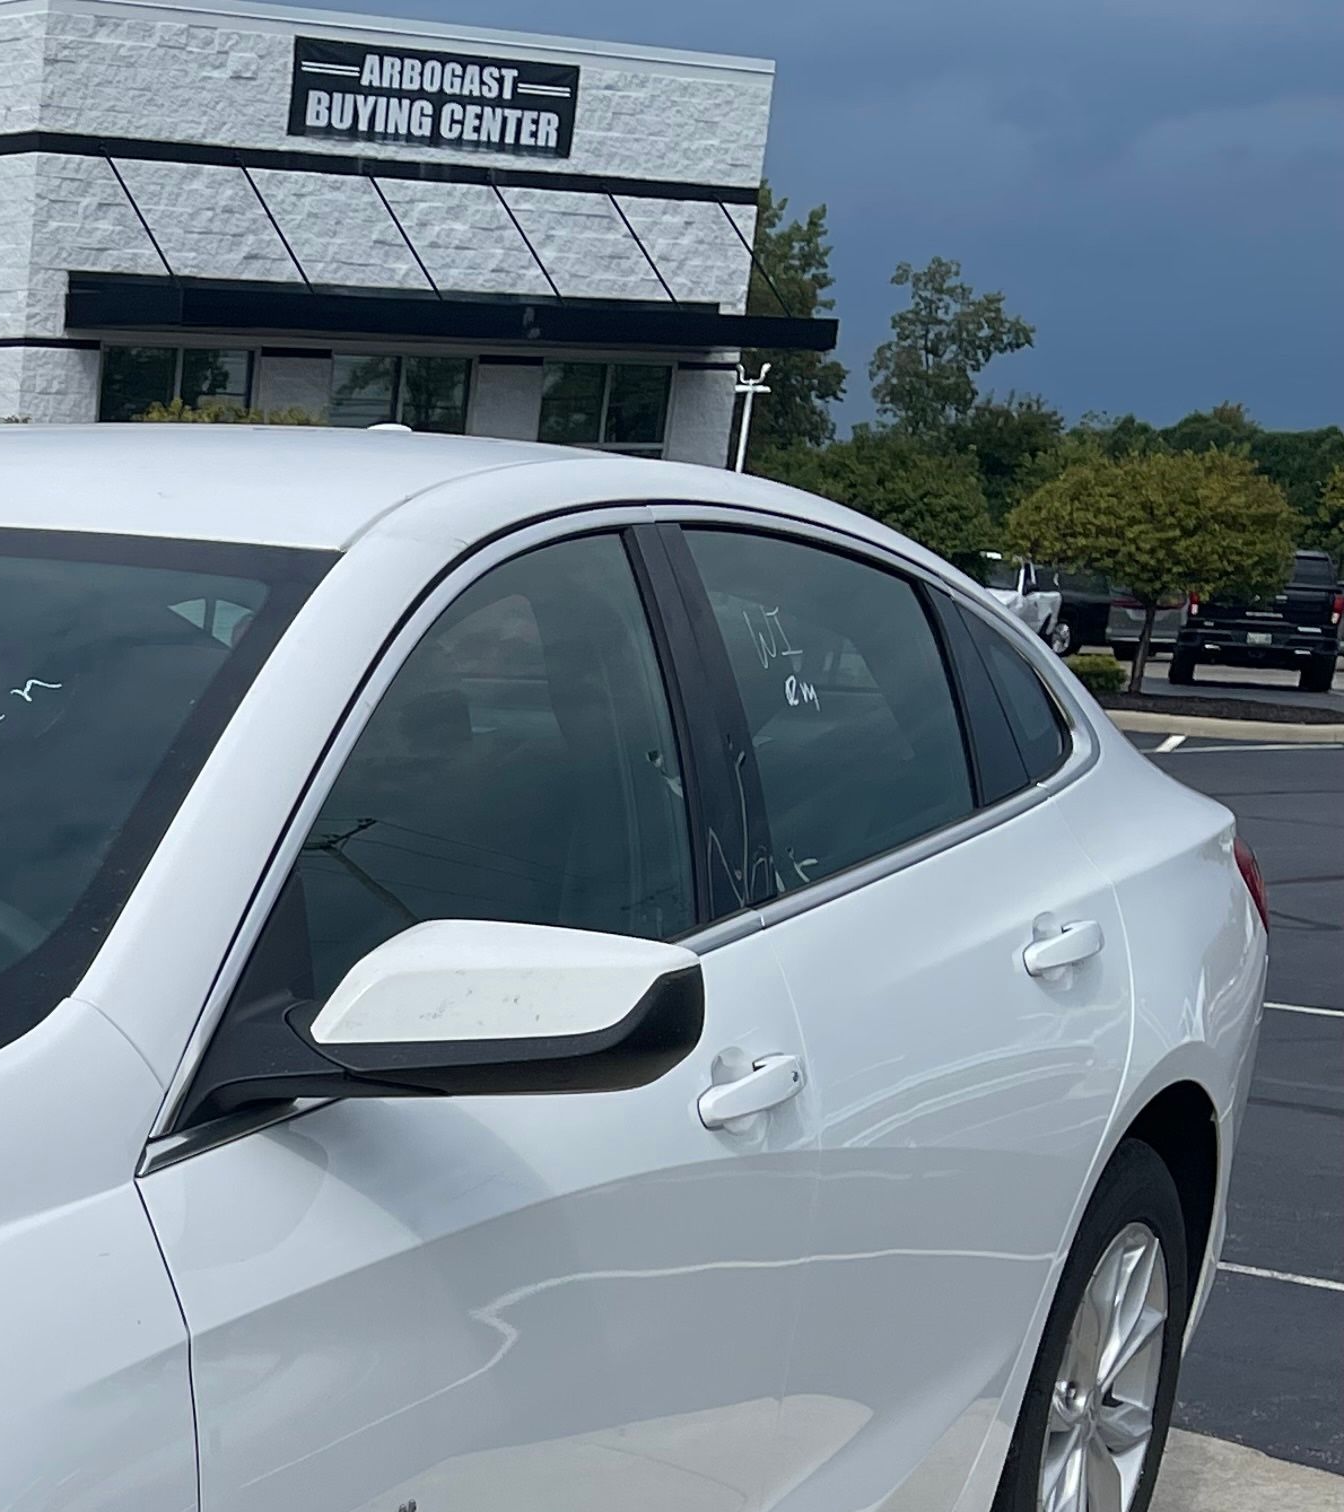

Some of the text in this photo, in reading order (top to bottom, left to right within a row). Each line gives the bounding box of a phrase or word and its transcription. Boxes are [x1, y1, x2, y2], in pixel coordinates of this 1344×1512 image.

[359, 53, 519, 100] ARBOGAST
[305, 89, 559, 148] BUYING CENTER
